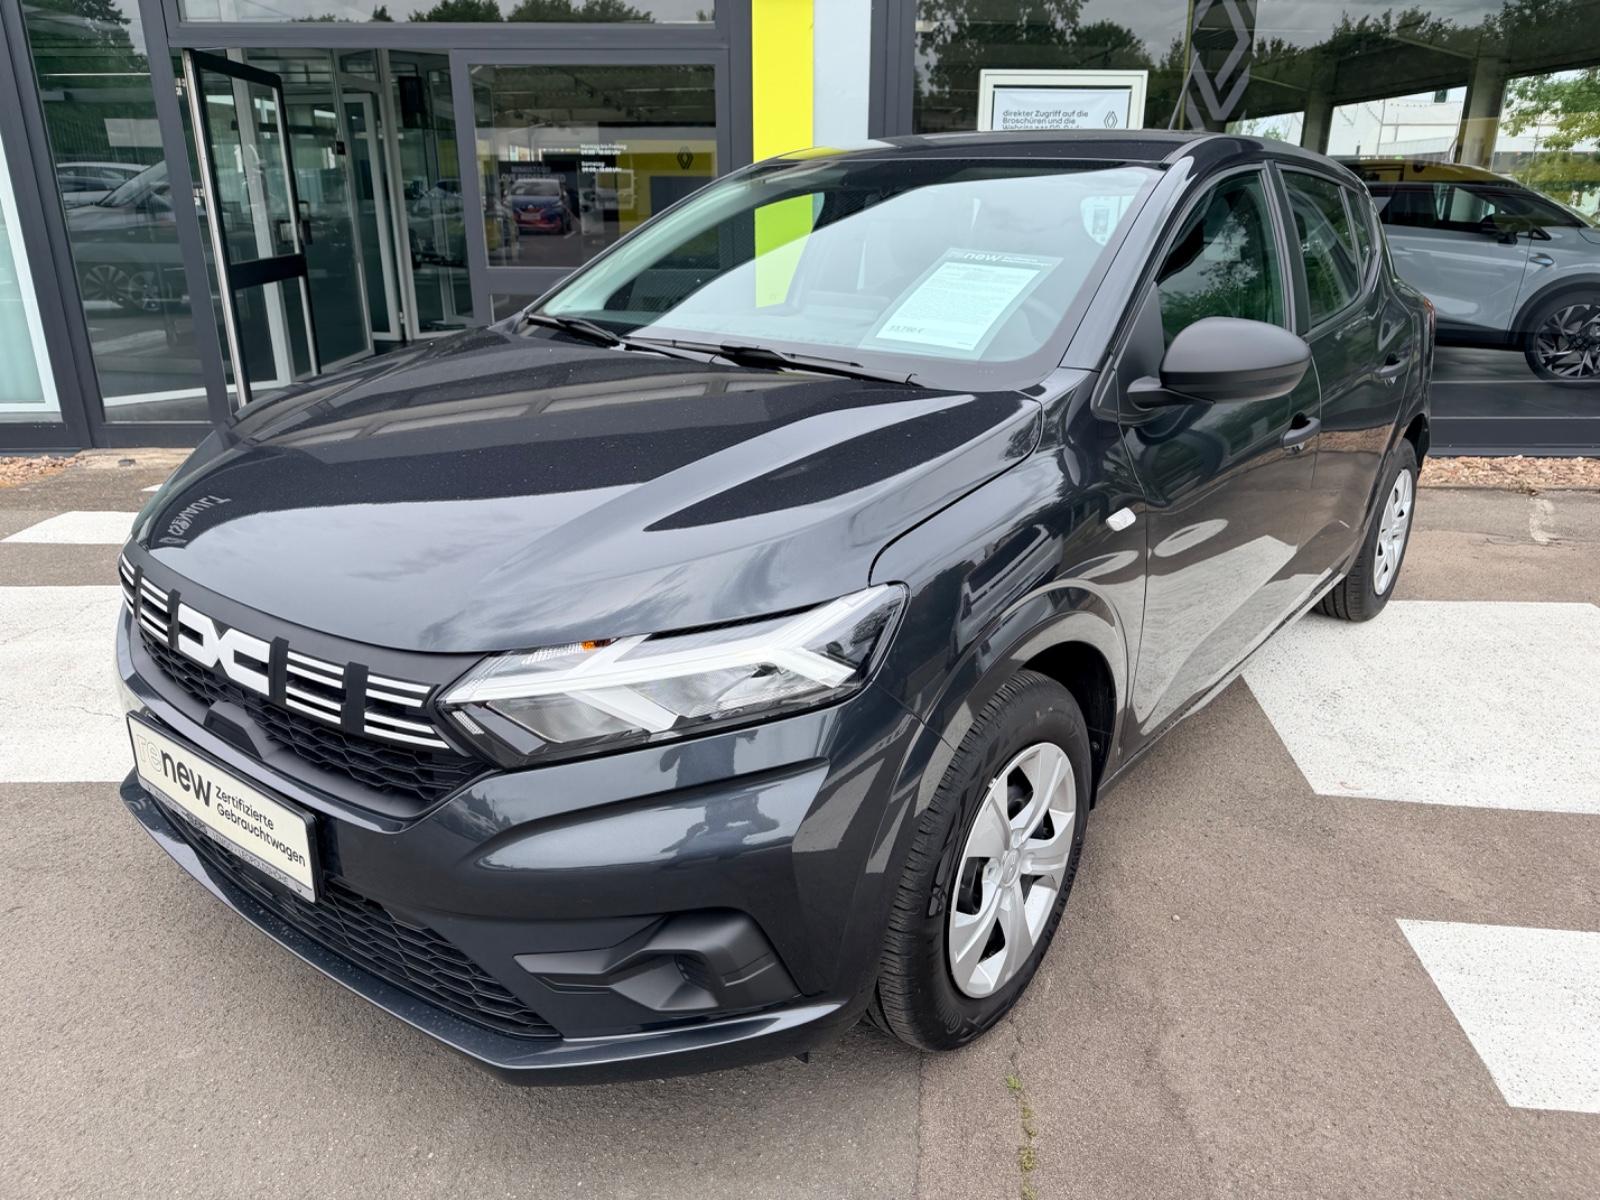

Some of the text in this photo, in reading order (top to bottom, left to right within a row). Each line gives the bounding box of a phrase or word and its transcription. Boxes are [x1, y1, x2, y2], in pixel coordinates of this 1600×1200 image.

[1034, 110, 1061, 119] Zugriff
[1076, 110, 1089, 118] die
[215, 785, 274, 830] Zertifizierte
[216, 803, 306, 867] Gebrauchtwagen
